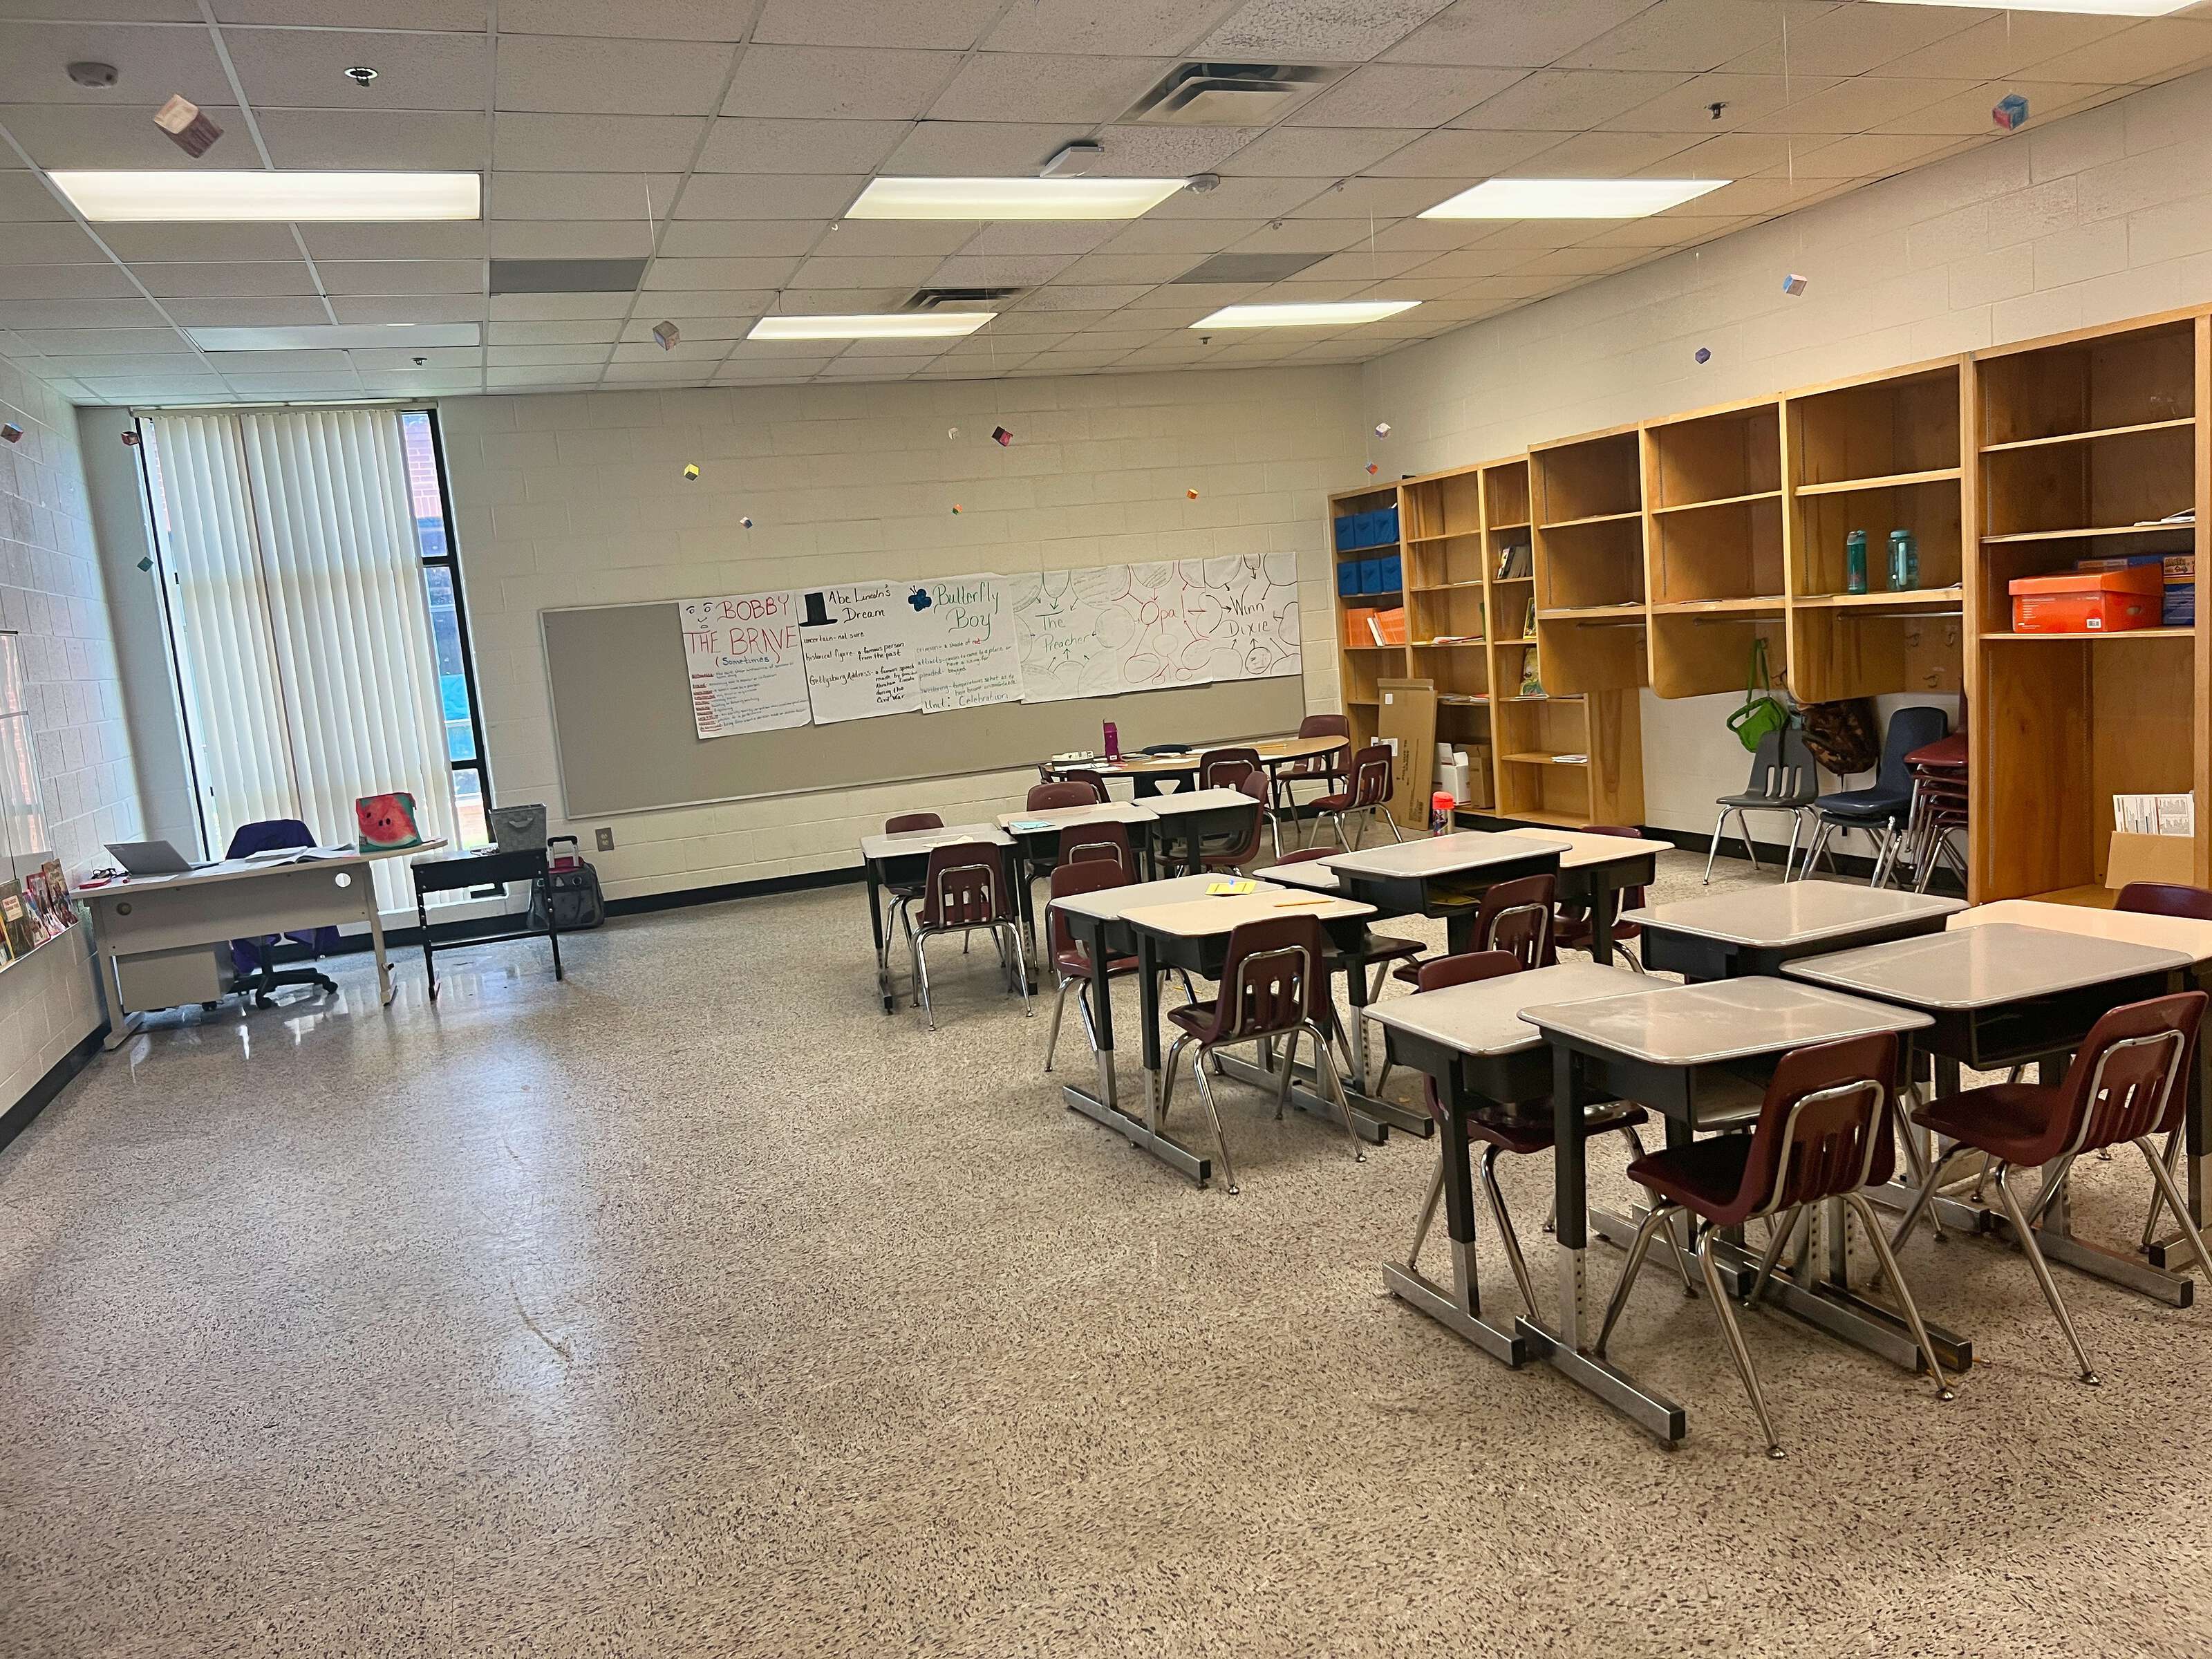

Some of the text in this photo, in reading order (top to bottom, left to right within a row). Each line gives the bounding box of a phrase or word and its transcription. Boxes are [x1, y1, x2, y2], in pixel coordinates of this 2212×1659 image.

[829, 584, 891, 605] Abe Lincoln's
[932, 582, 998, 614] Butterfly
[1230, 583, 1264, 616] Winn
[715, 594, 789, 621] BOBBY
[842, 608, 885, 623] Dream
[946, 607, 990, 641] Boy
[1035, 609, 1065, 630] The
[1221, 619, 1271, 639] Dixie
[683, 626, 798, 655] THE BRAVE
[1034, 632, 1091, 653] Preacher
[806, 650, 832, 662] historical
[884, 642, 904, 653] person
[886, 650, 901, 660] past
[809, 673, 847, 688] Gettysburg
[959, 692, 1009, 706] Celebration
